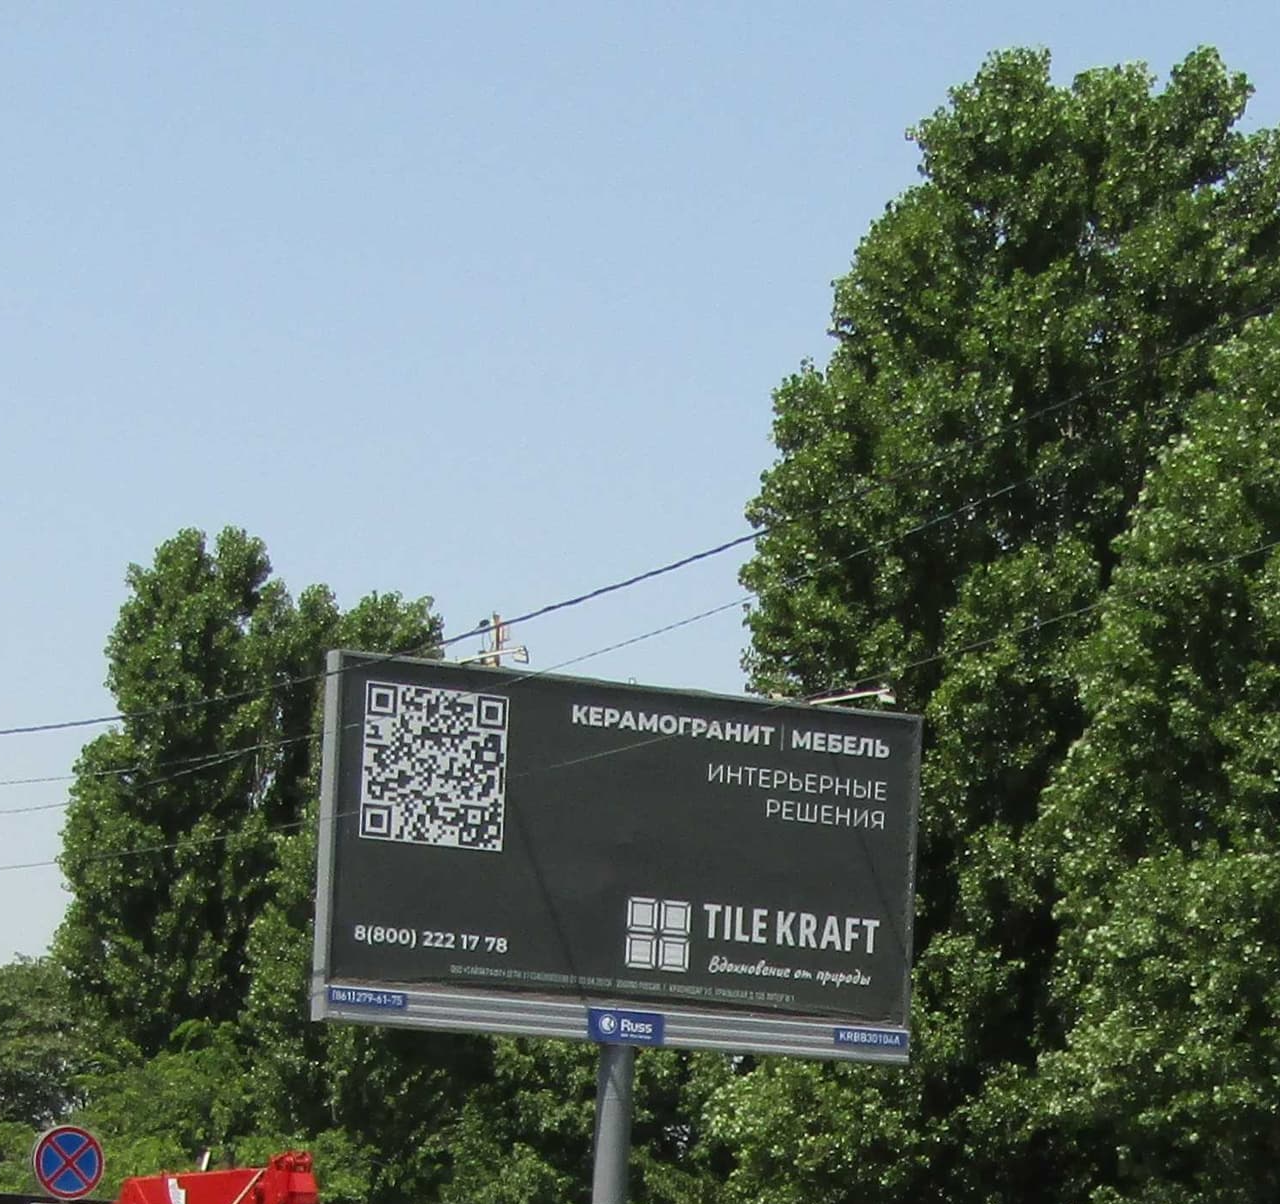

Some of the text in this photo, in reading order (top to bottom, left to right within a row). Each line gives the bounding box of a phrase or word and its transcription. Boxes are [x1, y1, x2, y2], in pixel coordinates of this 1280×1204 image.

[572, 704, 891, 759] КЕРАМОГРАНИТ МЕБЕЛЬ
[707, 763, 888, 801] ИНТЕРЬЕРНЫЕ
[765, 798, 886, 830] РЕШЕНИЯ
[354, 924, 508, 954] 8(800) 222 17 78
[703, 903, 881, 954] TILE KRAFT
[708, 955, 871, 989] Вдохновение от природы
